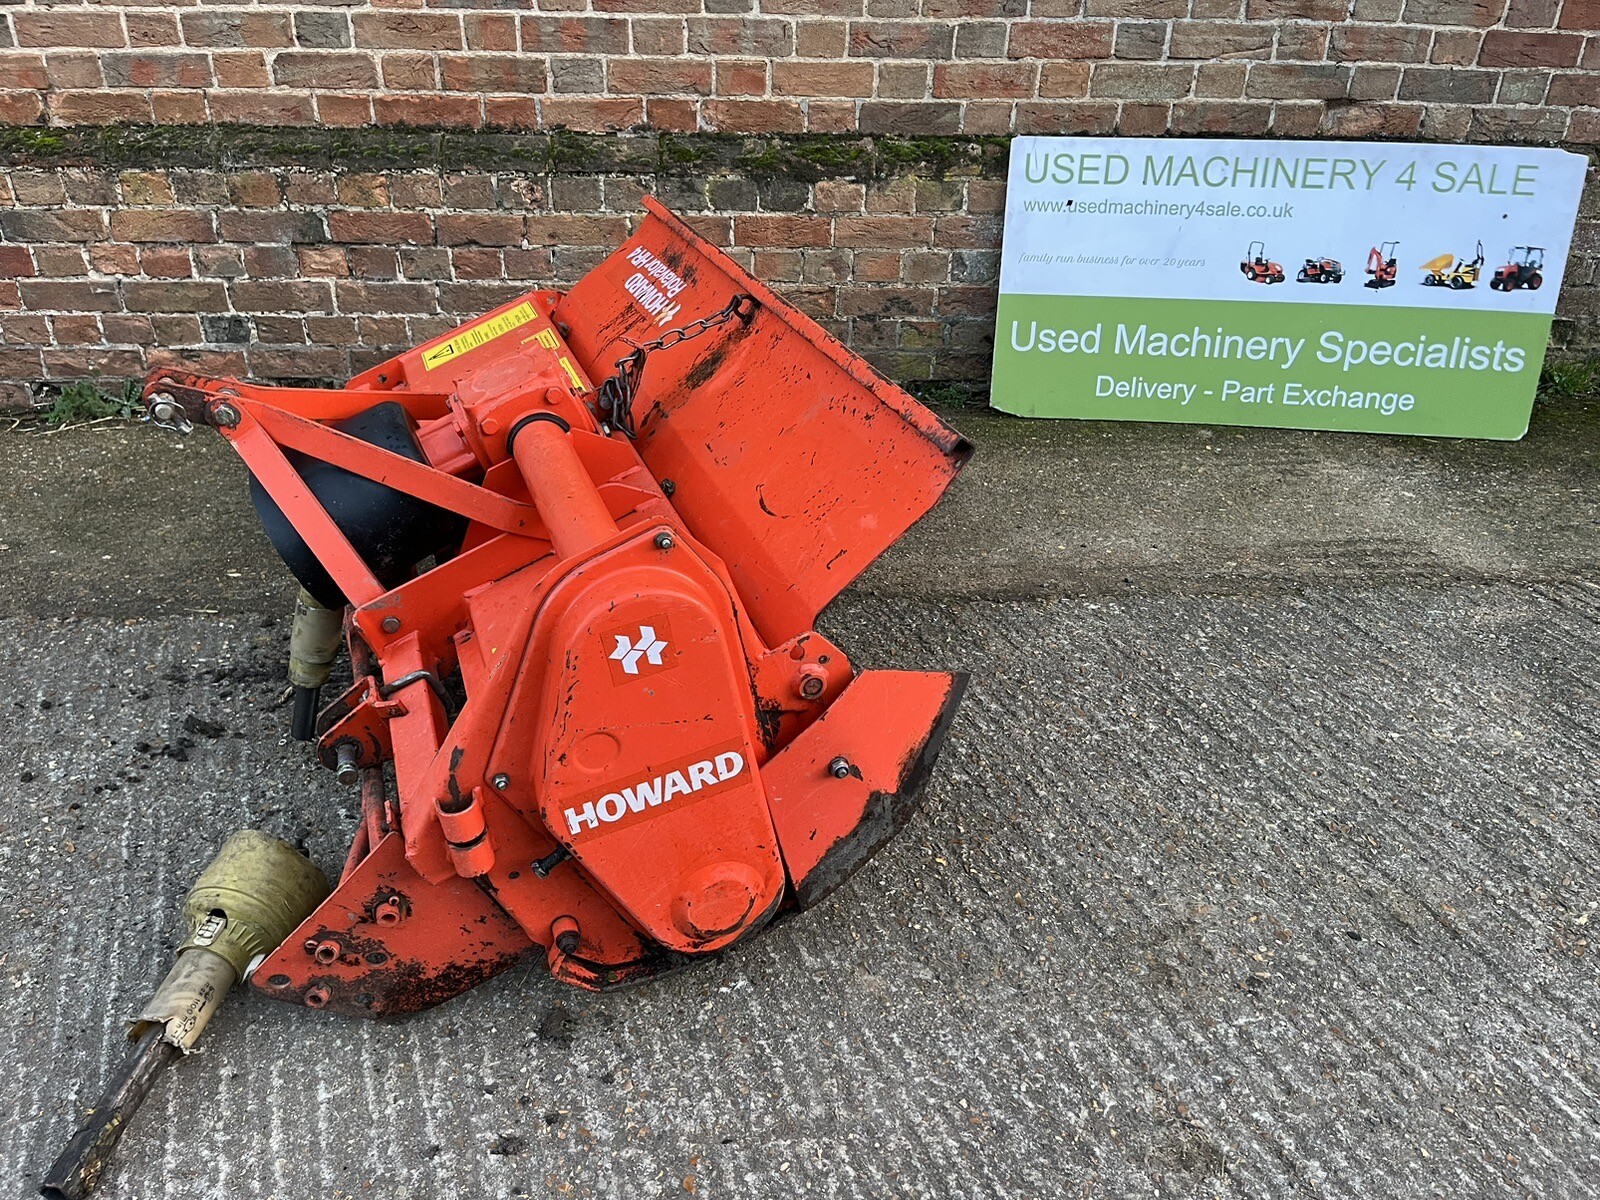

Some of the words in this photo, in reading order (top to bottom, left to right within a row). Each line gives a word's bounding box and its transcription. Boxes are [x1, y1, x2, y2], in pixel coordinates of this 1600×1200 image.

[1024, 153, 1130, 185] USED
[1142, 155, 1387, 190] MACHINERY
[1394, 161, 1416, 191] 4
[1431, 161, 1539, 196] SALE
[1023, 199, 1294, 219] www.usedmachinery4sale.co.uk
[626, 245, 654, 269] HR4
[1018, 252, 1053, 265] family
[1055, 254, 1075, 263] run
[1076, 254, 1119, 264] business
[1120, 255, 1137, 267] for
[1138, 257, 1161, 266] over
[1163, 257, 1176, 267] 20
[1176, 258, 1206, 269] years
[624, 272, 670, 316] HOWARD
[644, 258, 687, 298] Rotavator
[1010, 320, 1103, 354] Used
[1114, 323, 1306, 370] Machinery
[1316, 330, 1527, 373] Specialists
[1095, 375, 1198, 406] Delivery
[1221, 380, 1276, 404] Part
[1282, 383, 1416, 416] Exchange
[564, 751, 744, 835] HOWARD
